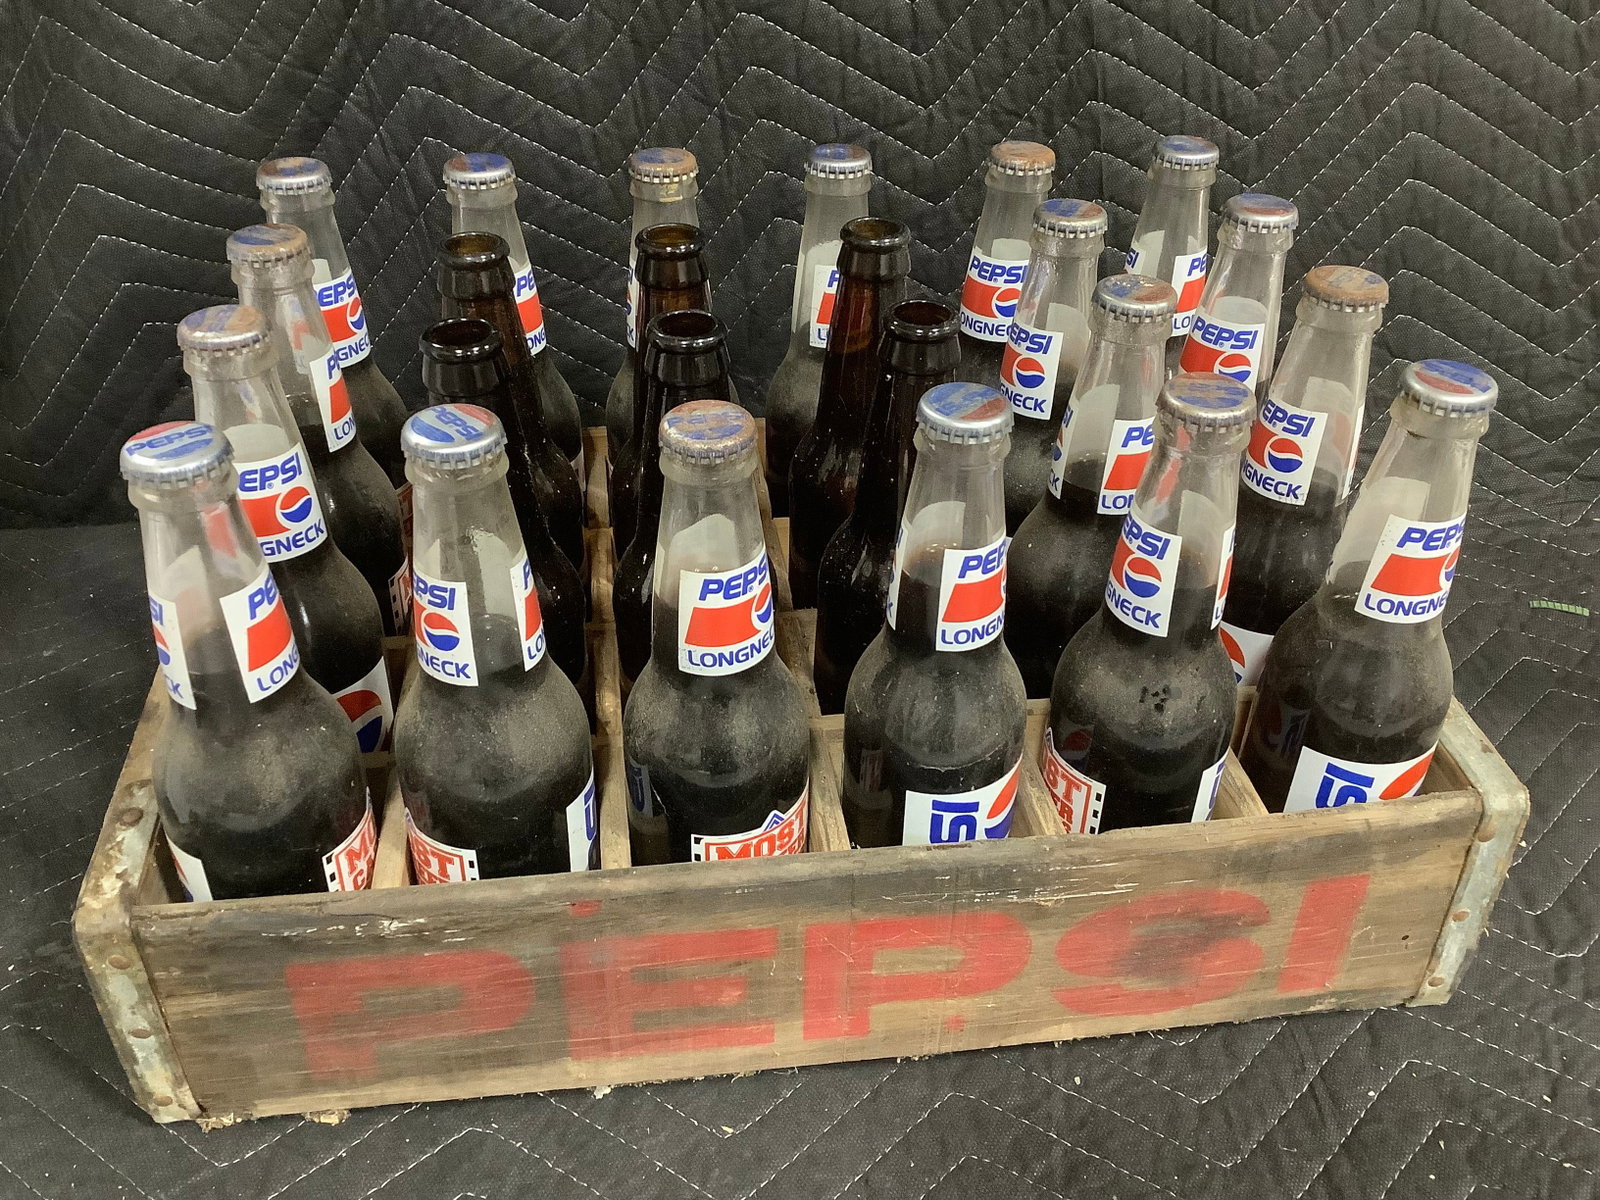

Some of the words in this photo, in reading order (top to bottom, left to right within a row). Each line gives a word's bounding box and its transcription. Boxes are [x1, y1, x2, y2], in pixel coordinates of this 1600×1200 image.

[970, 255, 1028, 284] PEPSI
[315, 274, 357, 307] EPS
[1191, 315, 1259, 350] PEPSI
[413, 570, 457, 611] PSI
[416, 643, 472, 679] NECK
[284, 873, 1371, 1082] PEPSI
